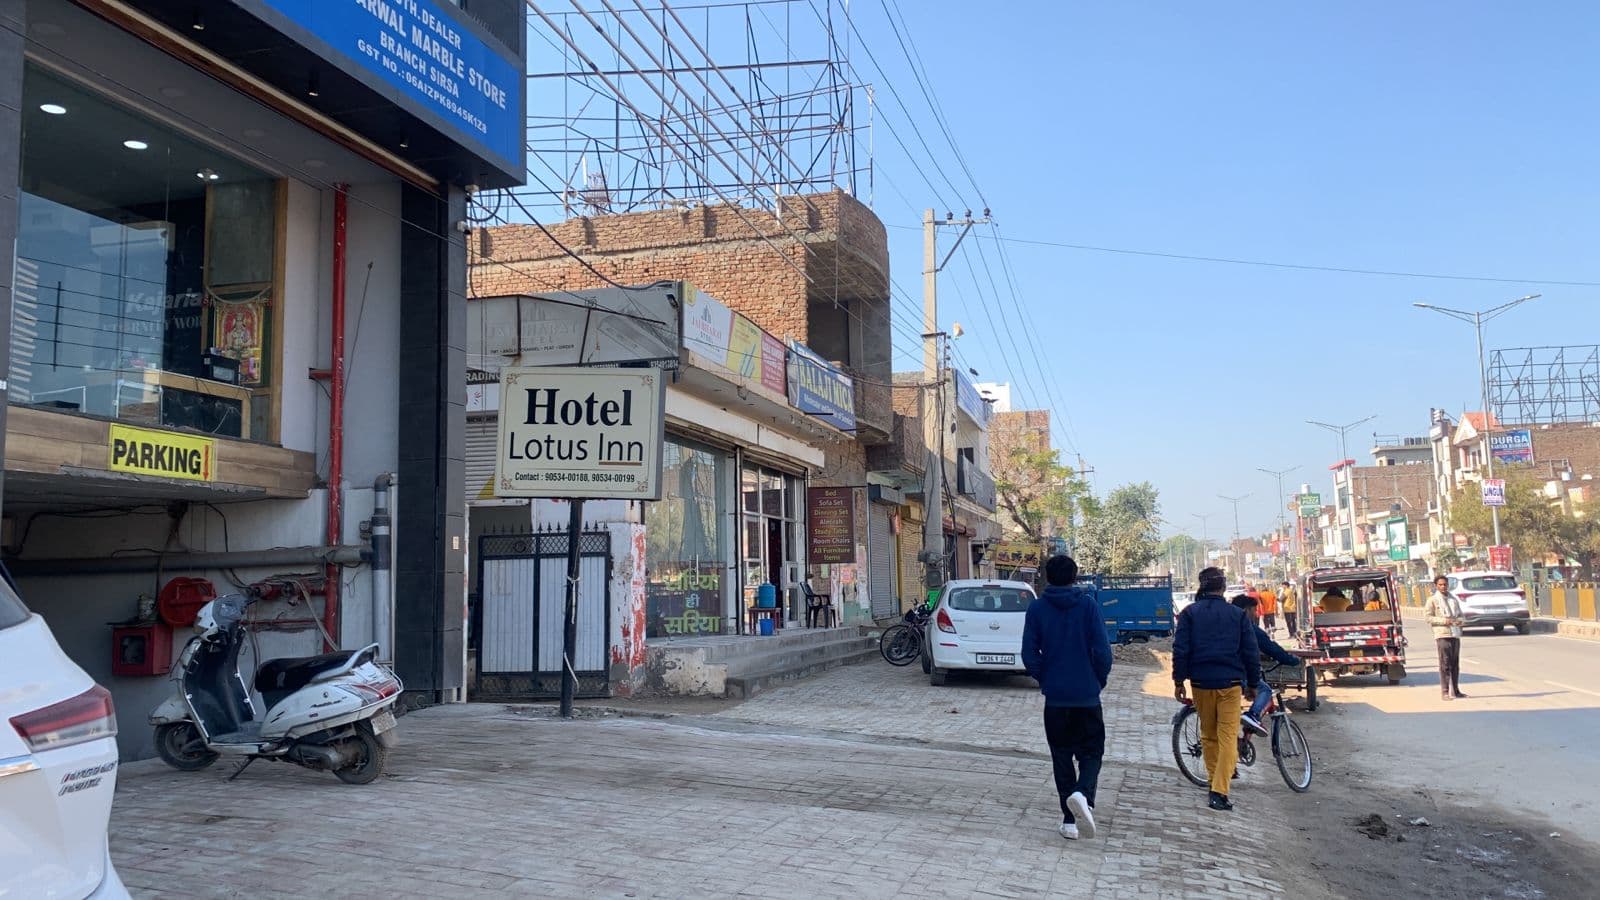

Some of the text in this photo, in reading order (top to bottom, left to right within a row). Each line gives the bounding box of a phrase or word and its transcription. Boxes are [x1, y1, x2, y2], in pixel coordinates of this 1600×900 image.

[358, 39, 380, 61] GST
[380, 31, 459, 98] BRANCH SIRSA
[412, 25, 465, 79] MARBLE
[469, 68, 506, 110] STORE
[799, 358, 833, 403] BALAJI
[523, 388, 633, 426] Hotel
[112, 438, 201, 475] PARKING
[509, 432, 644, 462] Lotus Inn
[1490, 435, 1528, 445] DURGA
[515, 472, 539, 481] Contact
[663, 609, 720, 634] सरिया
